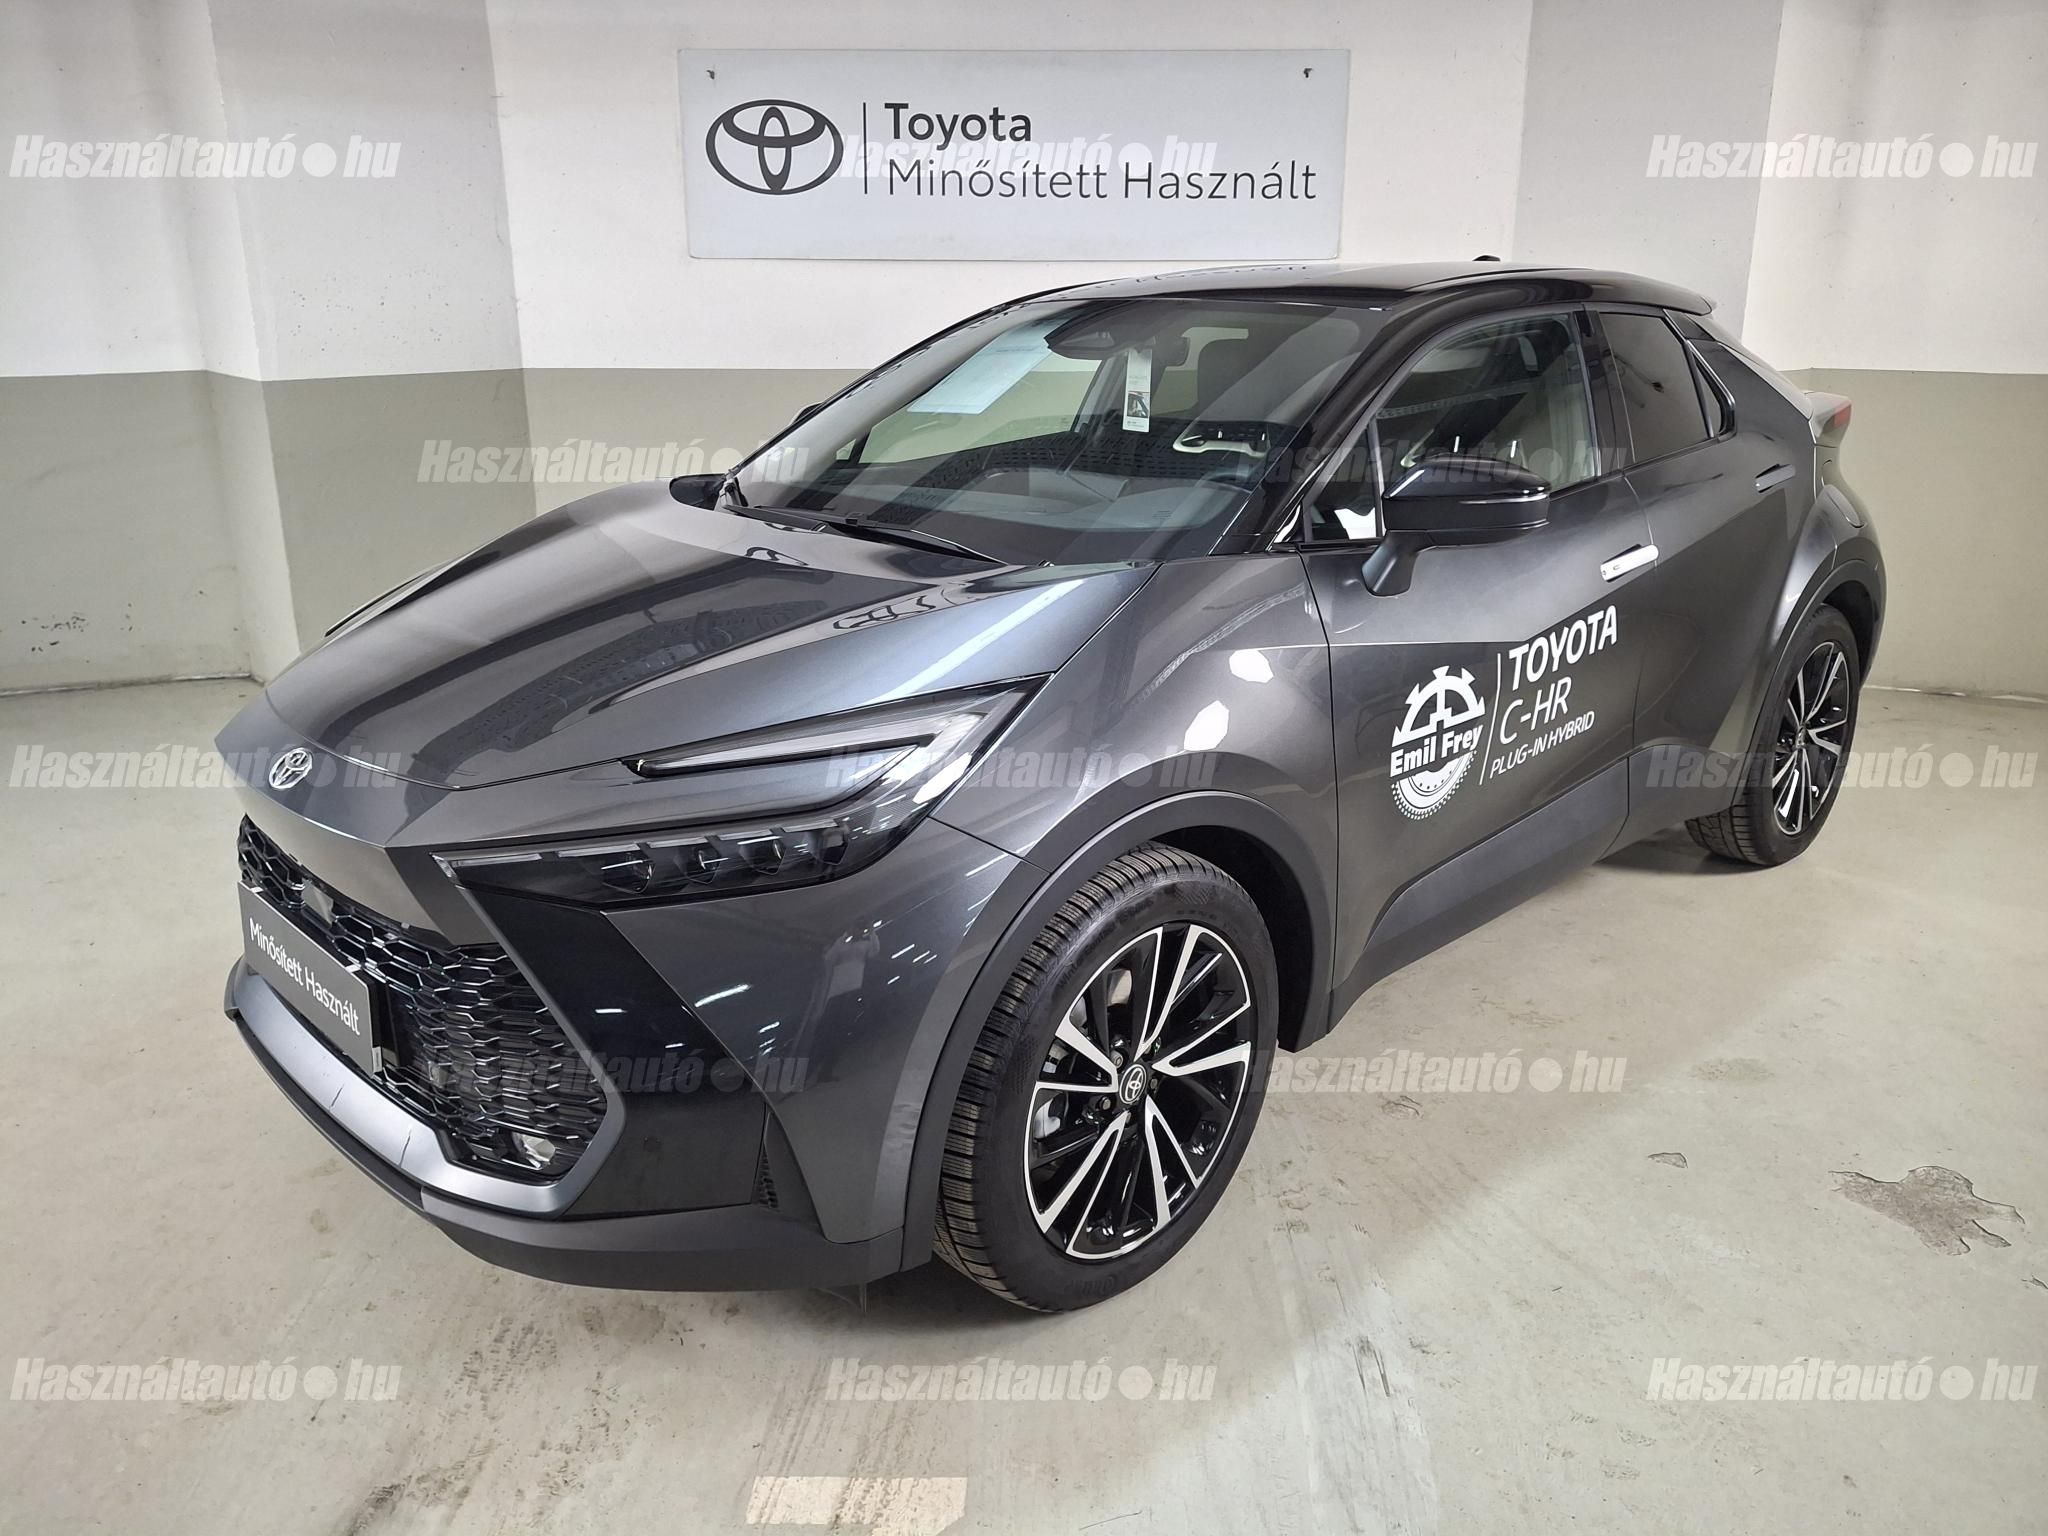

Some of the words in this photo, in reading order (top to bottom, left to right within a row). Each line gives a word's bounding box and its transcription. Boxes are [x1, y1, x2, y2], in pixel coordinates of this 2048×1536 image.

[886, 102, 1033, 149] Toyota
[887, 158, 1108, 200] Minősített
[1124, 160, 1318, 200] Használt
[1508, 604, 1618, 691] TOYOTA
[1500, 676, 1572, 745] C-HR
[1390, 735, 1437, 778] Emil
[1441, 724, 1484, 759] Frey
[1489, 734, 1548, 779] PLUG-IN
[1547, 711, 1595, 750] HYBRID
[250, 917, 304, 986] Minősített
[304, 966, 361, 1036] Használt
